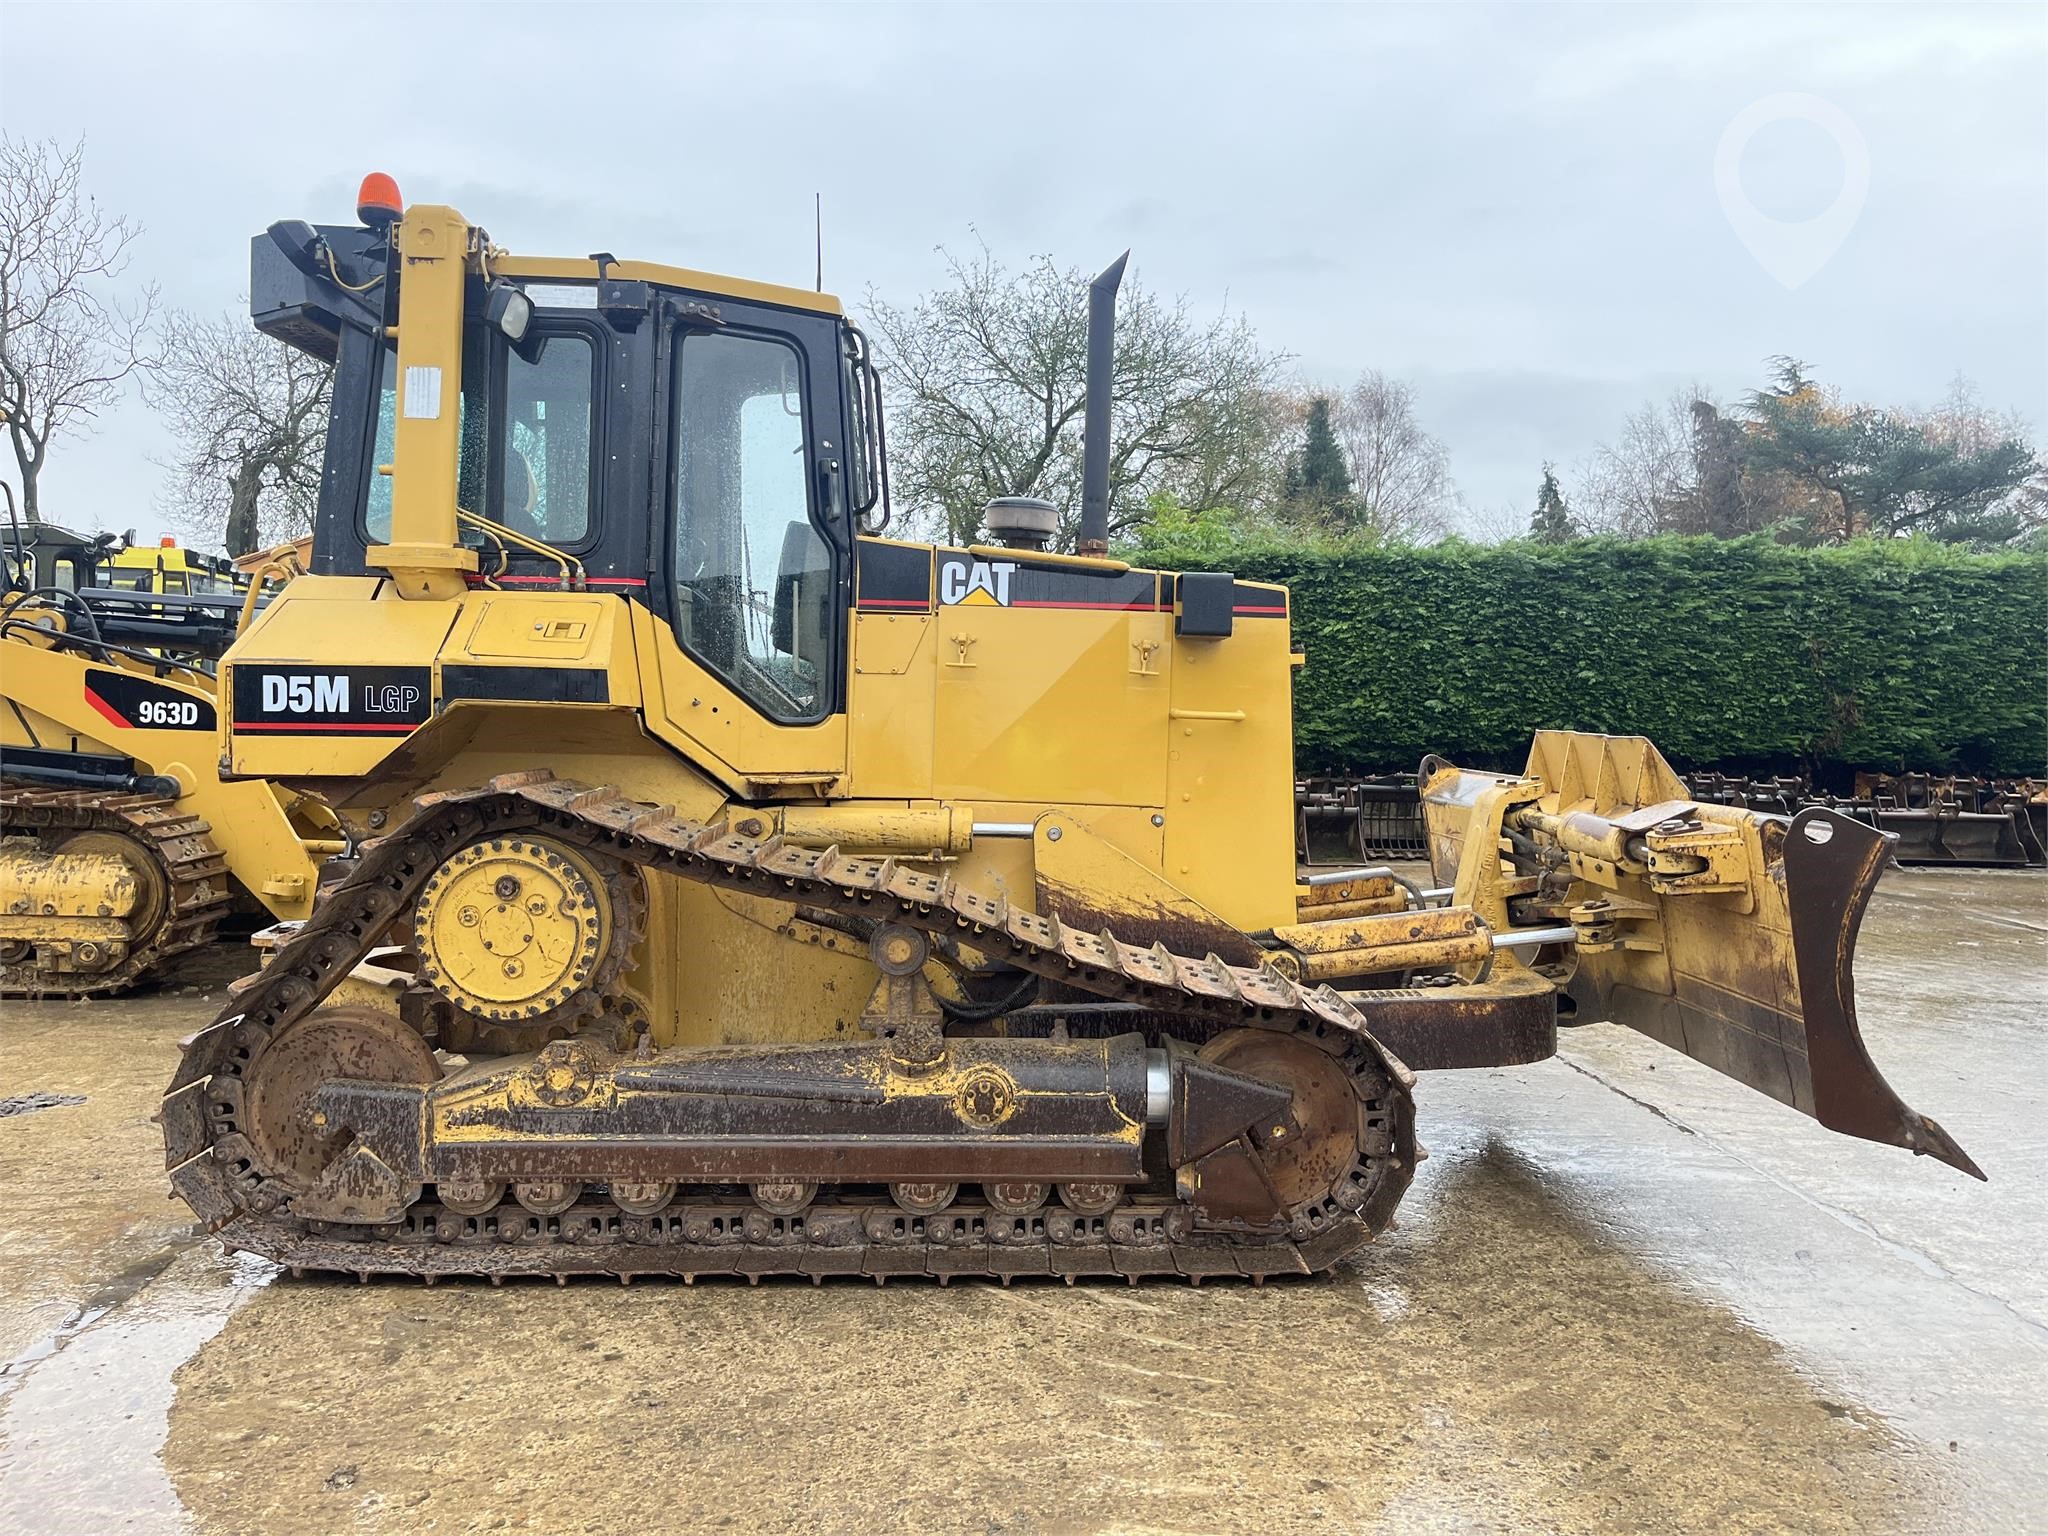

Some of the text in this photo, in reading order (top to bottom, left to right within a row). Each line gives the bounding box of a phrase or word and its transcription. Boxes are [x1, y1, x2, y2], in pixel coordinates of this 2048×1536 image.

[941, 561, 1016, 607] CAT
[139, 700, 198, 725] 963D
[262, 674, 420, 713] D5M LGP
